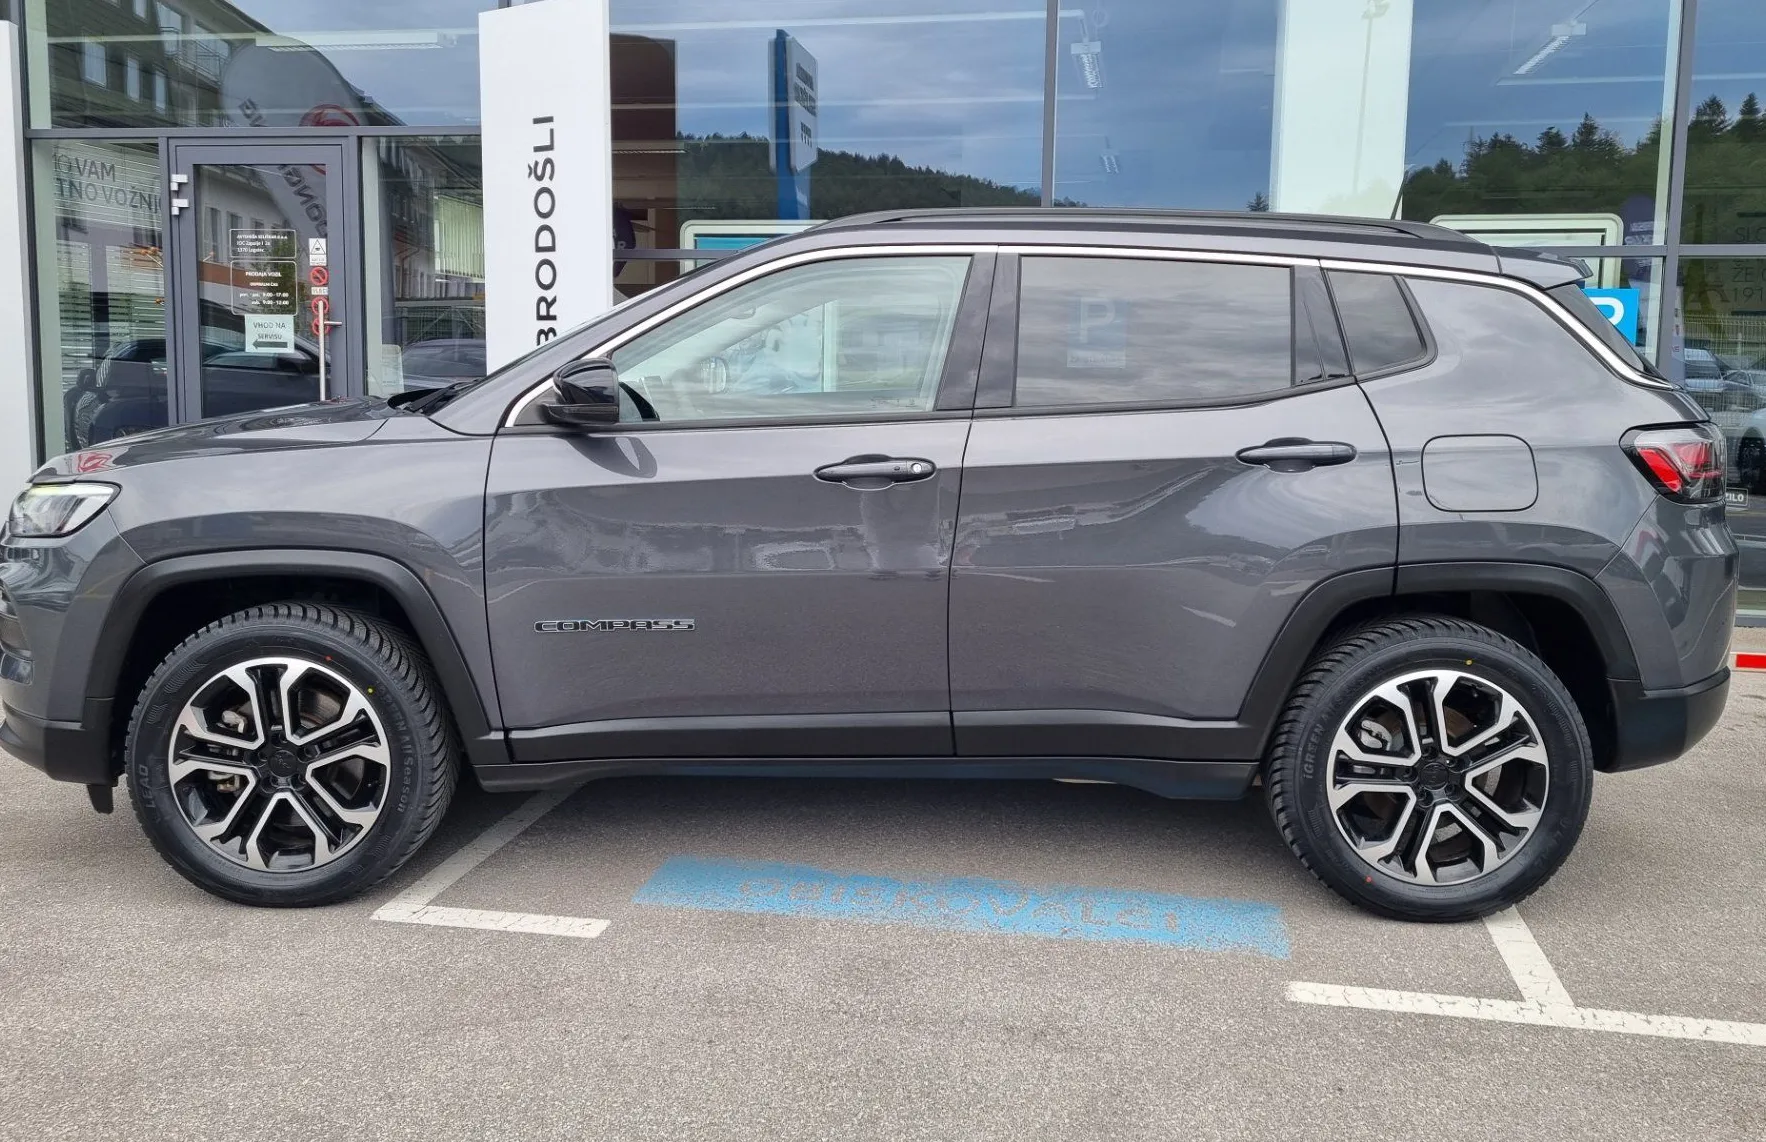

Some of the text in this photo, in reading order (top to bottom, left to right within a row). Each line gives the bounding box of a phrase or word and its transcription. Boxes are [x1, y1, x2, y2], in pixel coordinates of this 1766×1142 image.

[75, 157, 116, 182] VAM
[534, 619, 696, 632] COMPASS
[1303, 722, 1324, 780] iGREEN
[396, 756, 415, 813] Season
